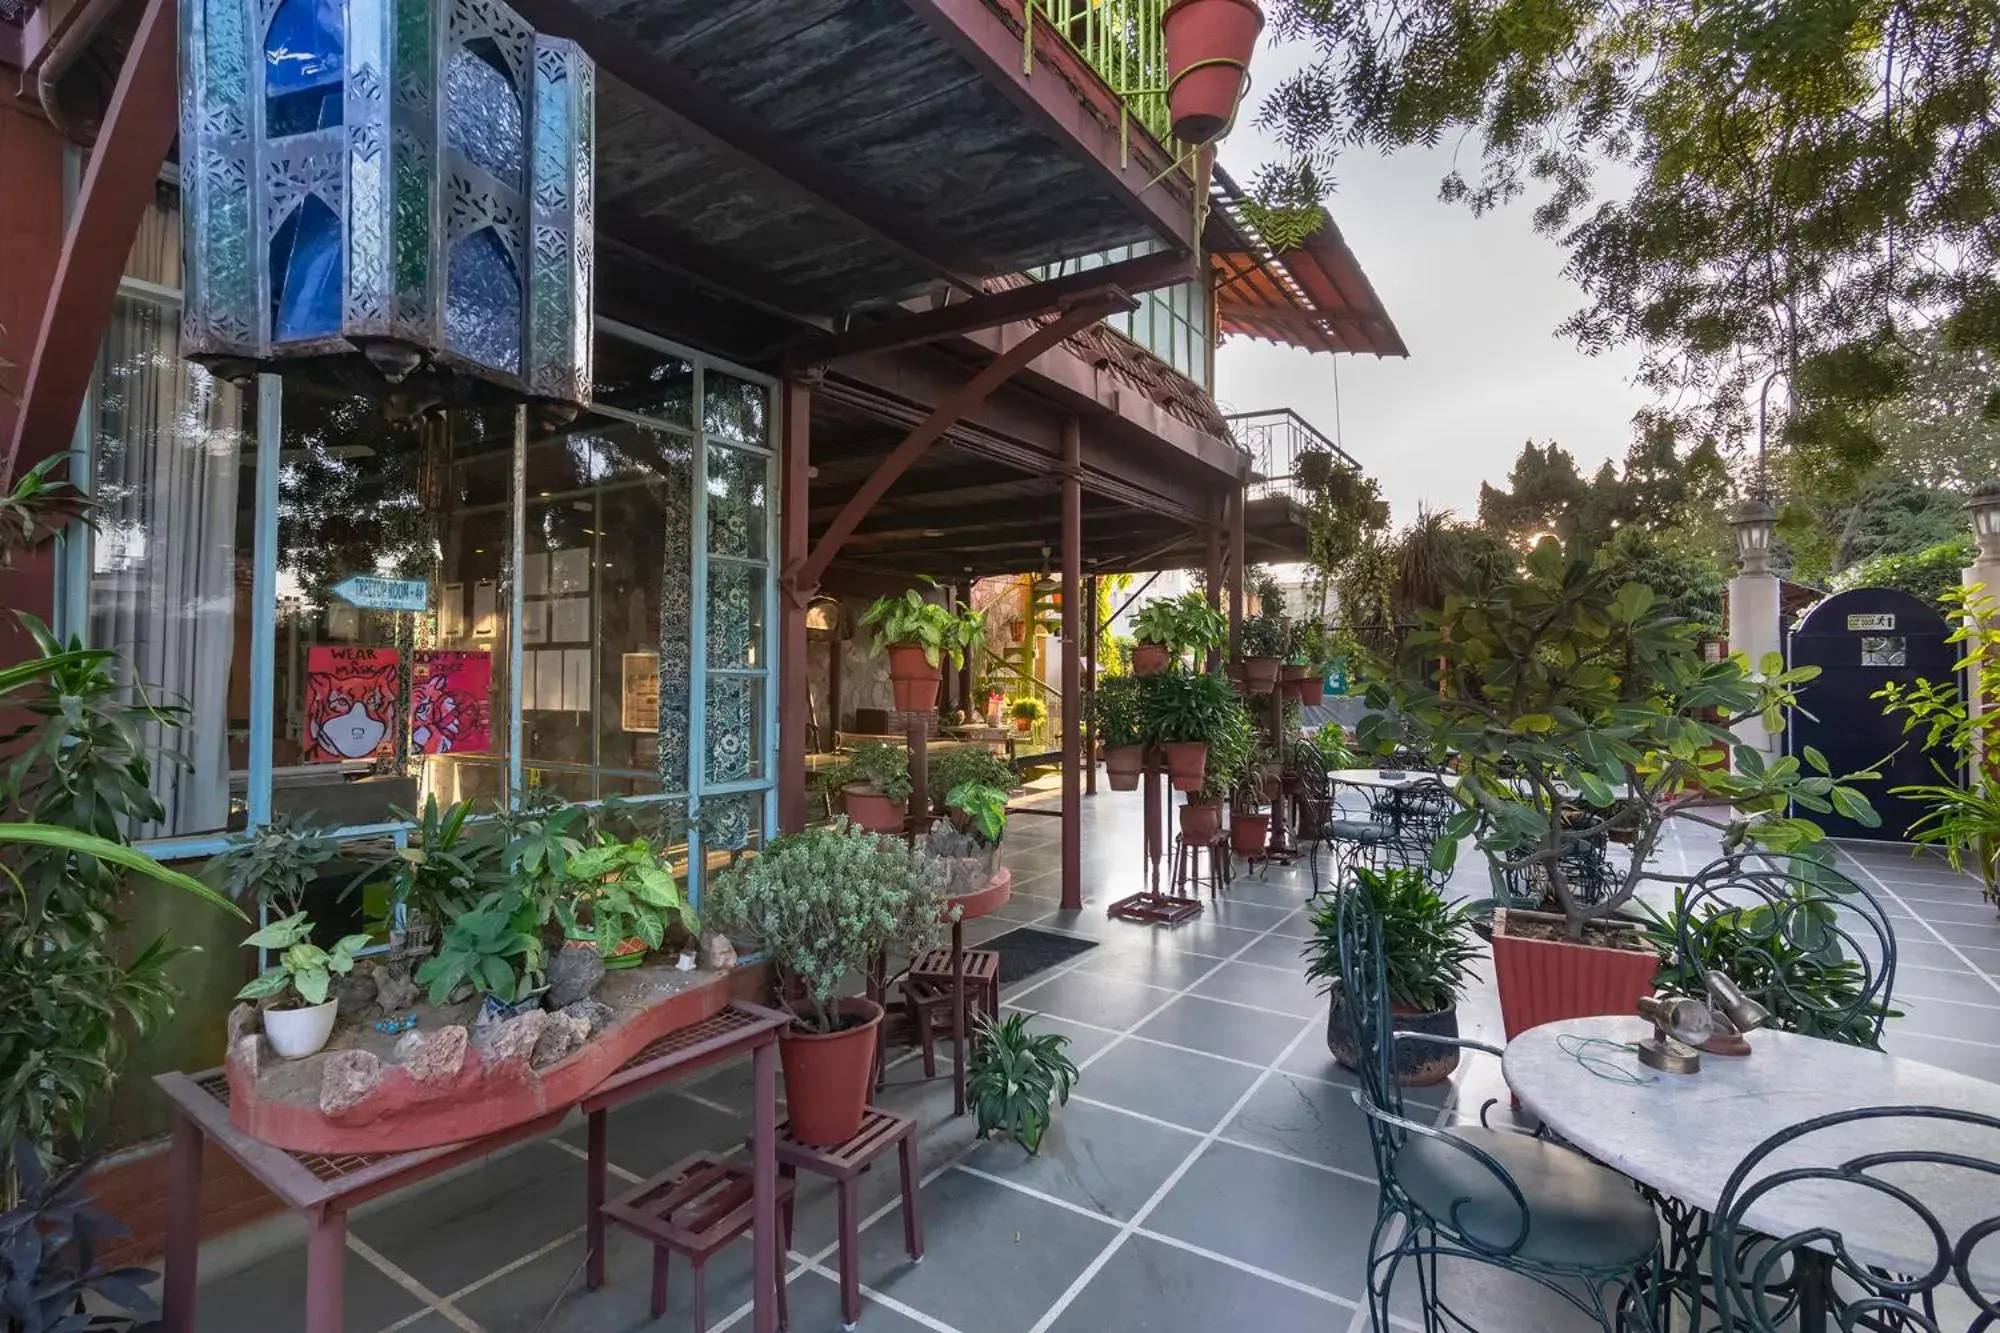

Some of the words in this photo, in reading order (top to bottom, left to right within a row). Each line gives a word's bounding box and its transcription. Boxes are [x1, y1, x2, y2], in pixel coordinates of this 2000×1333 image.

[387, 580, 409, 599] ROOM
[330, 648, 378, 660] WEAR
[335, 664, 375, 675] MASK
